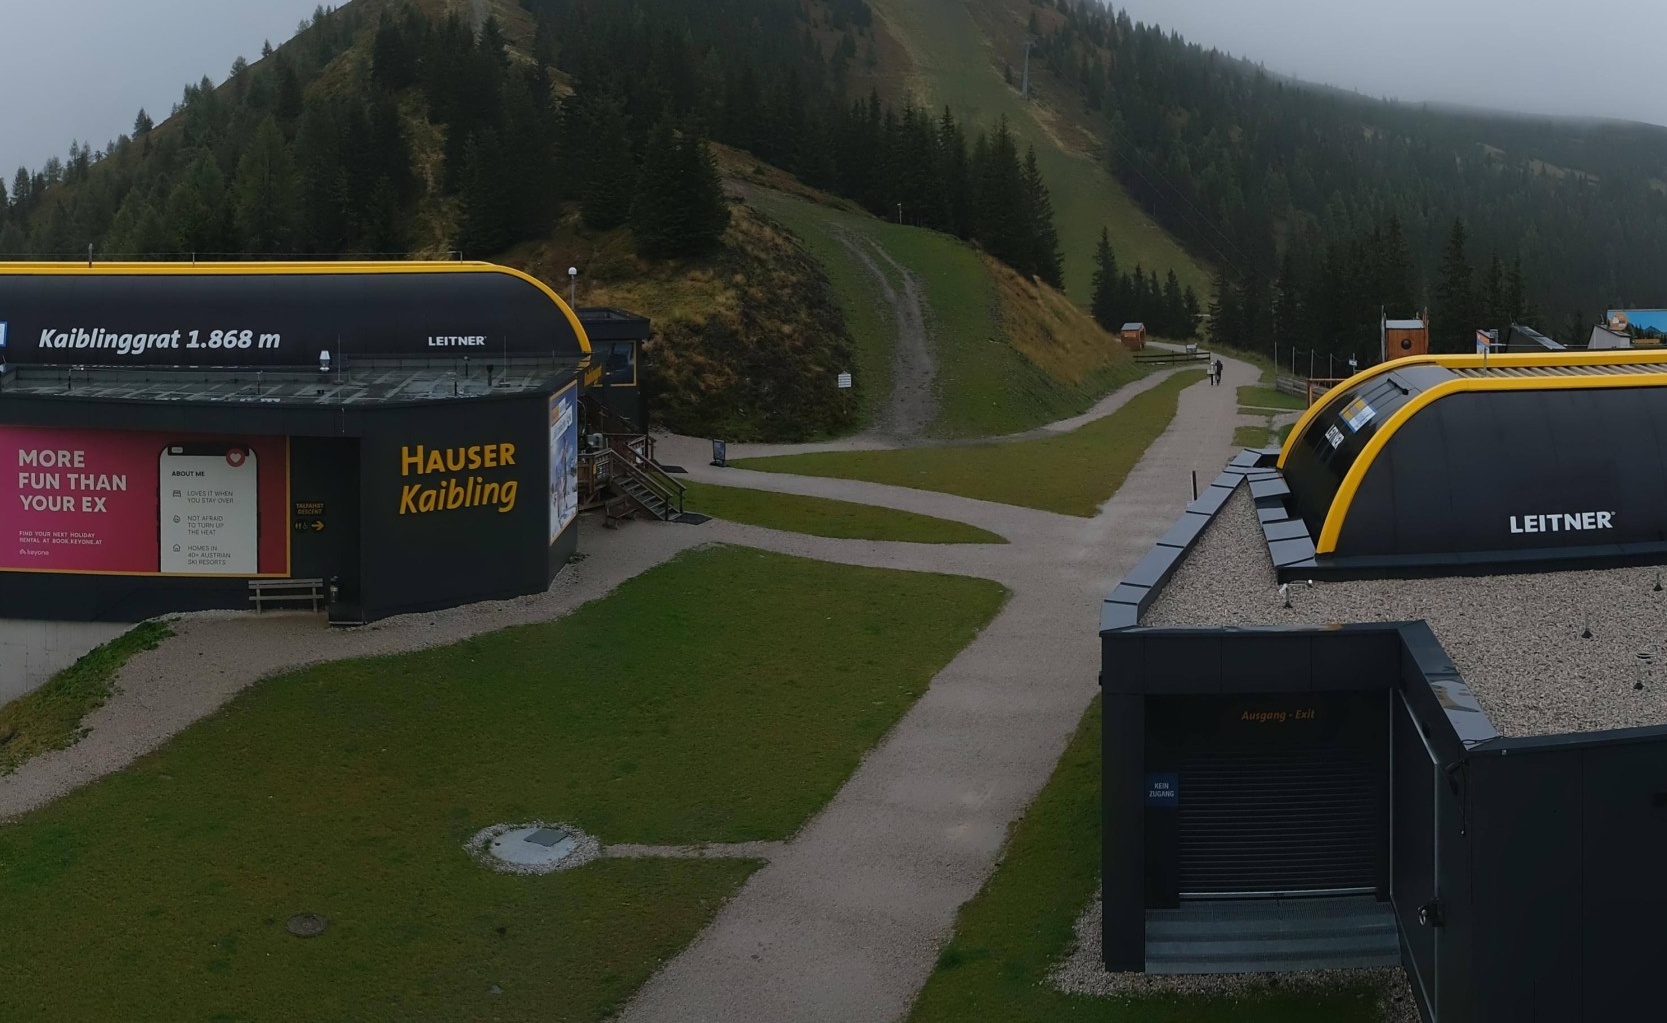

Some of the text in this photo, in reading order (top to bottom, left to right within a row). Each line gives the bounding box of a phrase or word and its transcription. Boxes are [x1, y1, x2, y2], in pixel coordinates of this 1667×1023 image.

[38, 328, 281, 355] Kaiblinggrat 1.868 m
[428, 336, 486, 346] LEITNER
[18, 449, 85, 468] MORE
[401, 443, 516, 476] HAUSER
[18, 472, 127, 491] FUN THAN
[19, 495, 107, 513] YOUR EX
[399, 476, 518, 515] Kaibling
[1509, 510, 1613, 534] LEITNER
[1241, 710, 1287, 722] Ausgang
[1295, 709, 1316, 719] Exit
[1149, 790, 1175, 798] ZUGANG
[1154, 782, 1169, 790] KEIN
